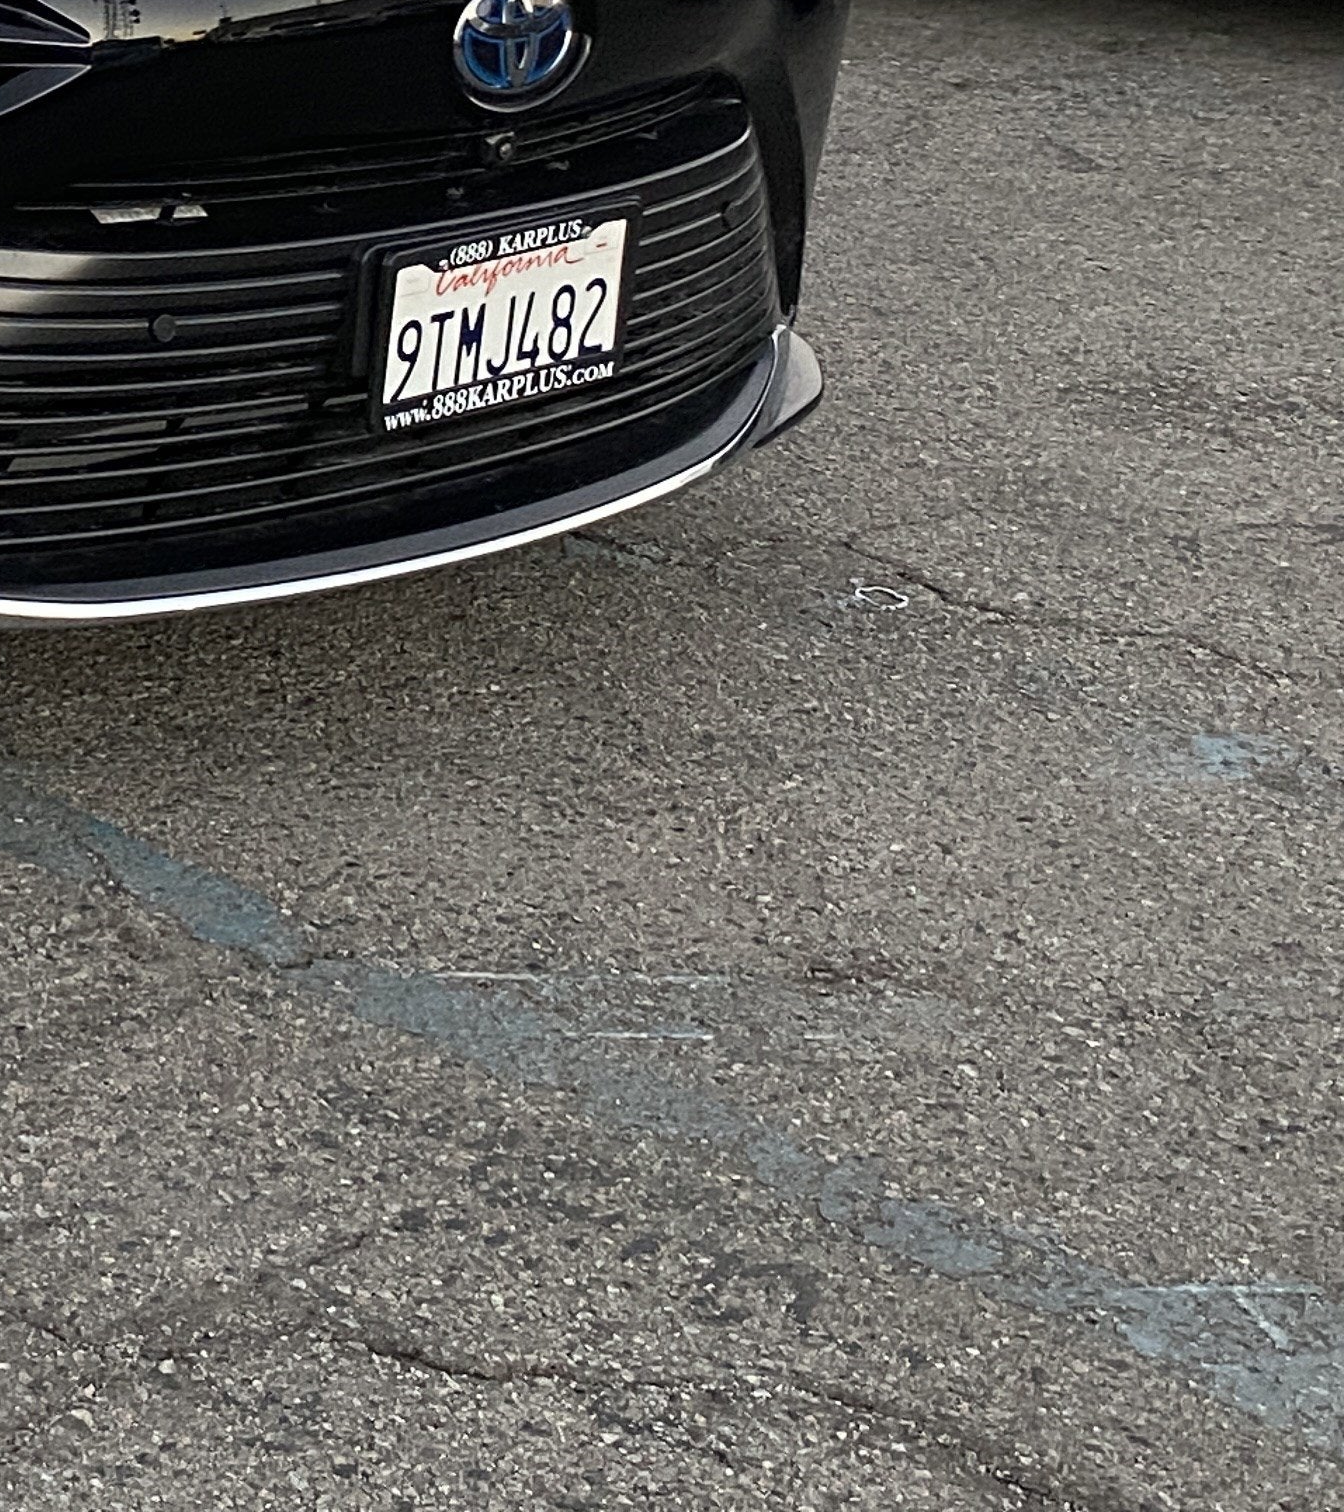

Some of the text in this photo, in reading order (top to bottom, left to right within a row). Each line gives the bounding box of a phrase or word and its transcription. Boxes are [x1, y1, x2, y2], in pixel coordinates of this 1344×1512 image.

[450, 219, 583, 265] (888) KARPLUS
[436, 246, 585, 296] California
[390, 277, 607, 403] 9TMJ482
